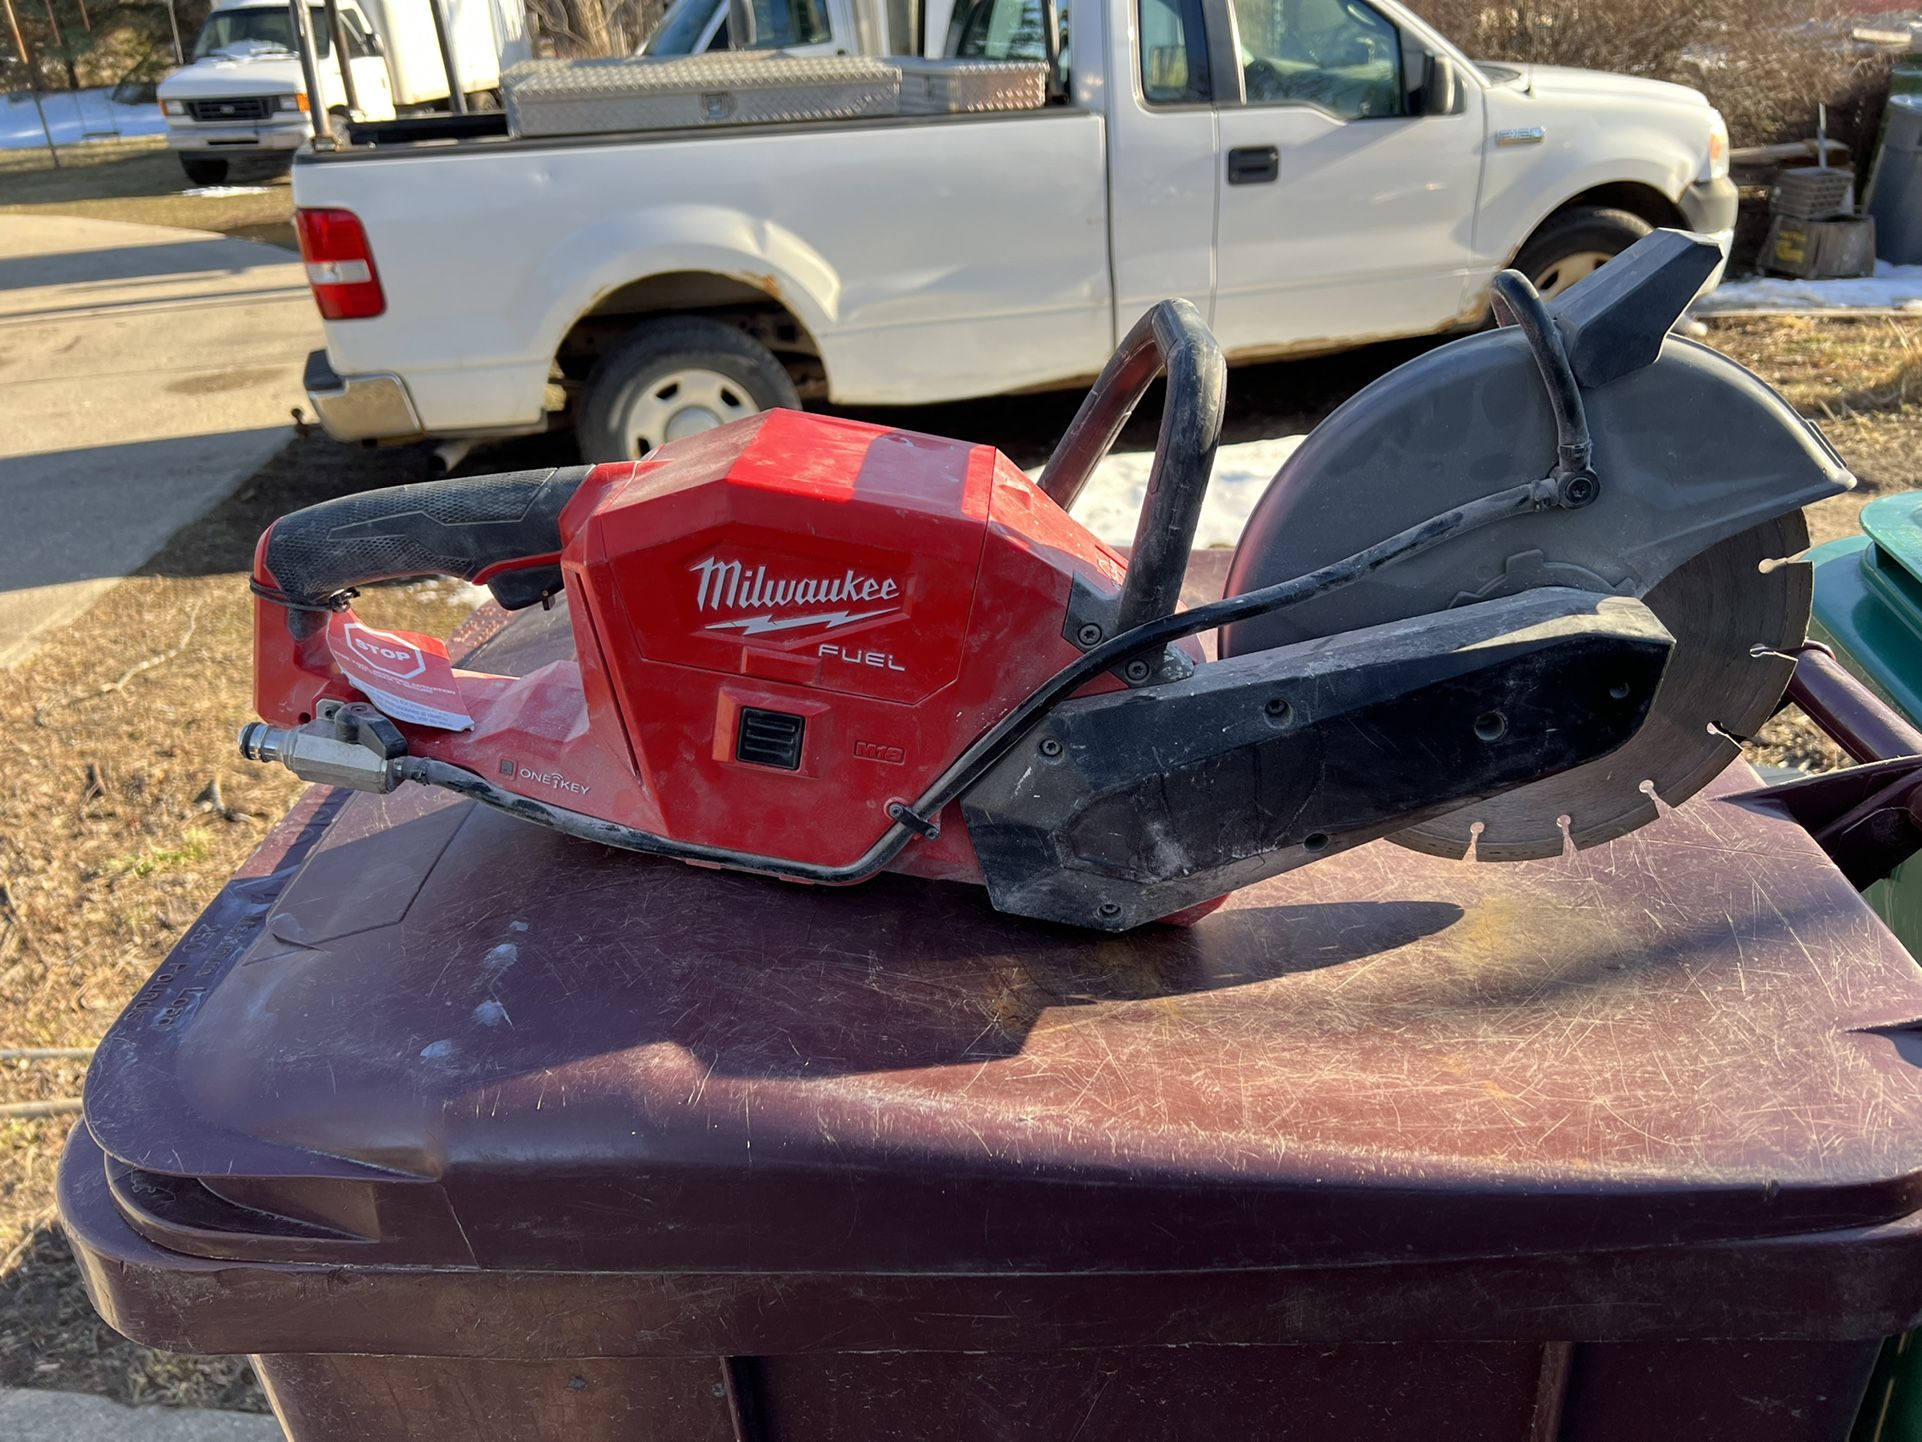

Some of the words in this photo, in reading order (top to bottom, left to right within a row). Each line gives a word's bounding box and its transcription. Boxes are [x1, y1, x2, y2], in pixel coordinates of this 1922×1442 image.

[689, 556, 900, 612] Milwaukee
[355, 638, 410, 660] STOP
[818, 644, 906, 671] FUEL
[855, 741, 904, 762] M18
[125, 963, 192, 1020] Pounds
[152, 987, 207, 1031] Load
